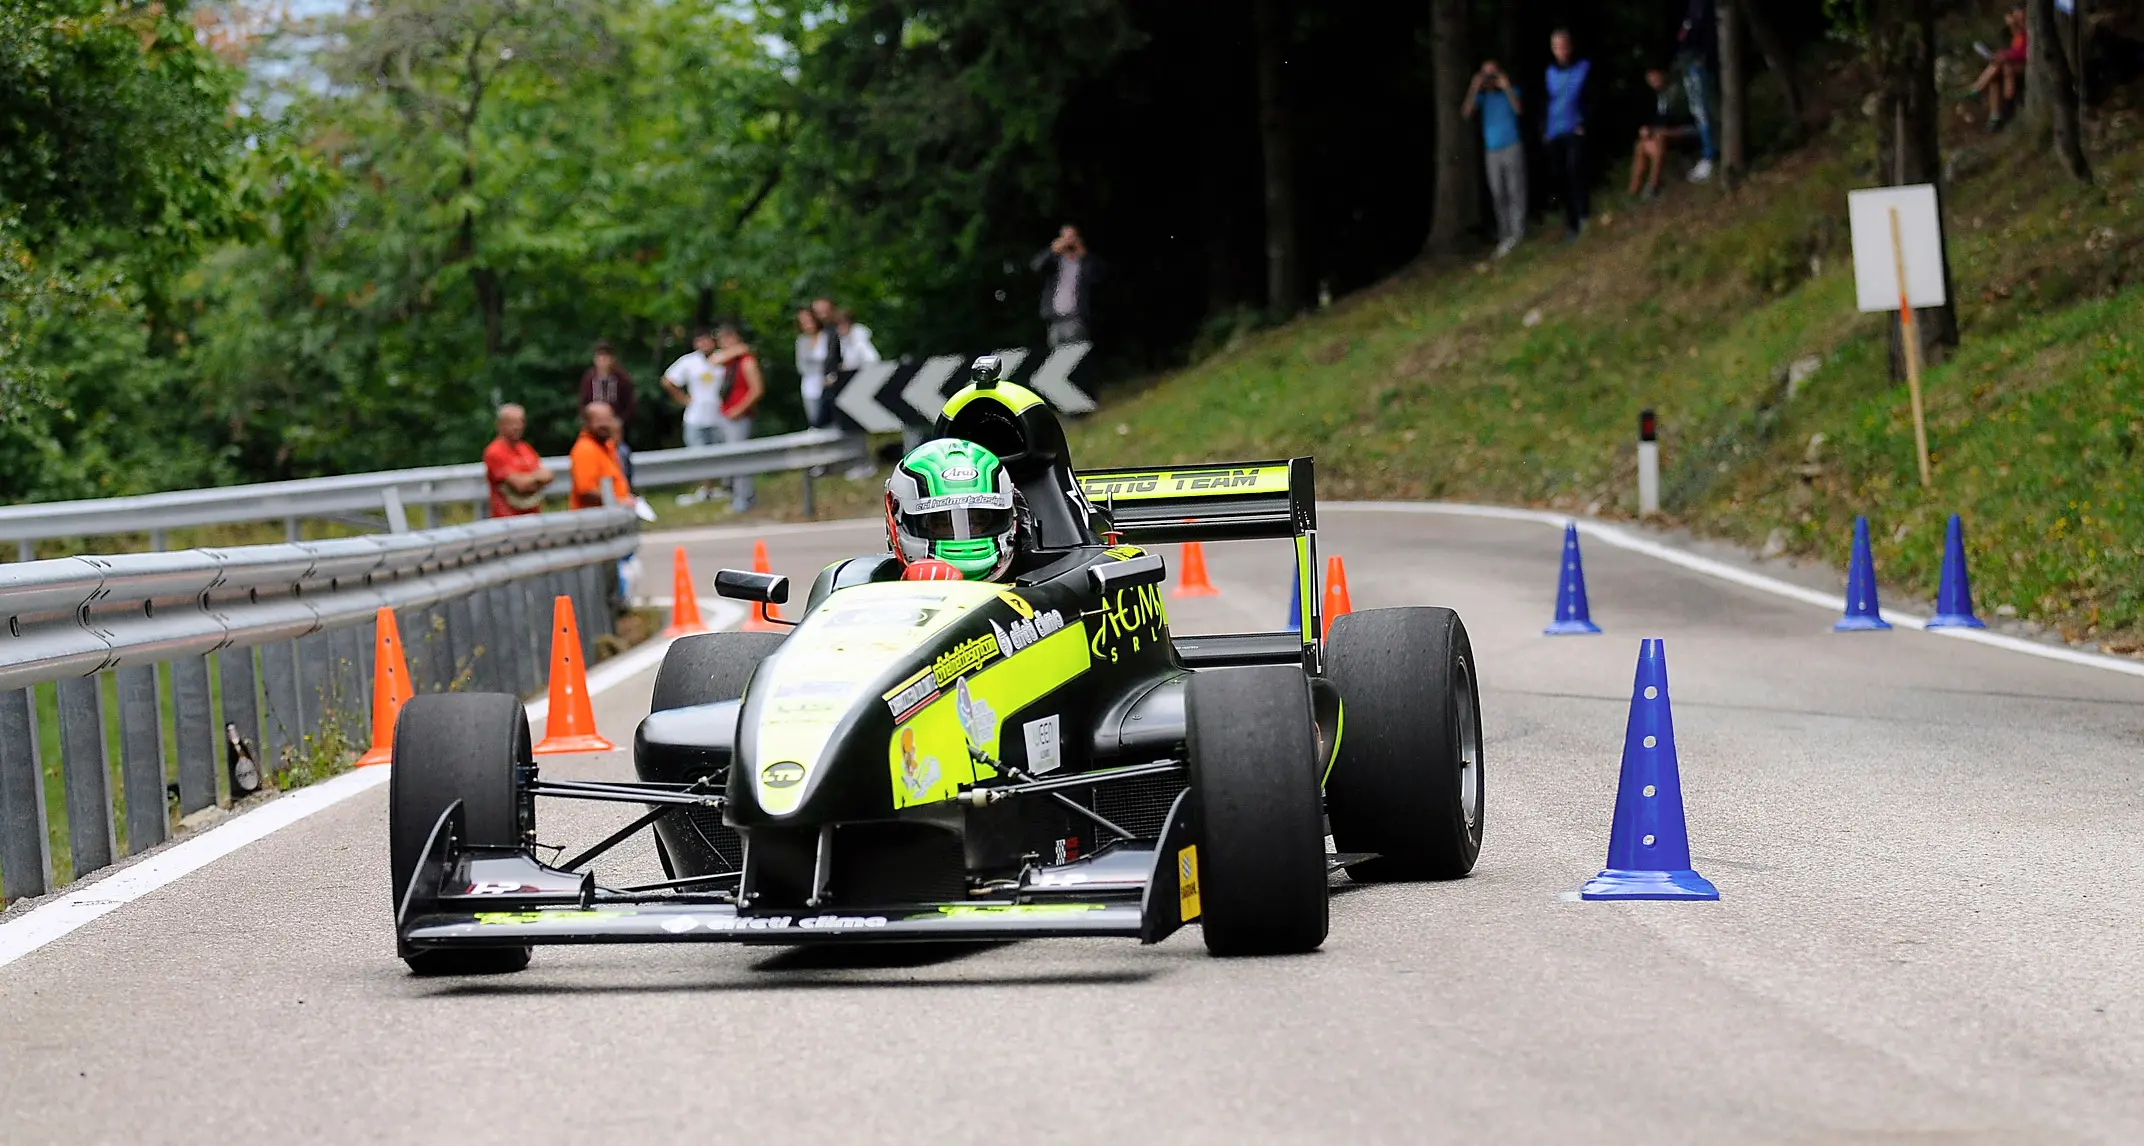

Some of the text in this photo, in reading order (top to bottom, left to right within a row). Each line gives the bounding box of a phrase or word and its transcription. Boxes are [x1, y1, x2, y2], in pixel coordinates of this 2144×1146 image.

[948, 467, 974, 476] Arai
[1170, 468, 1260, 491] TEAM
[799, 916, 888, 929] clima
